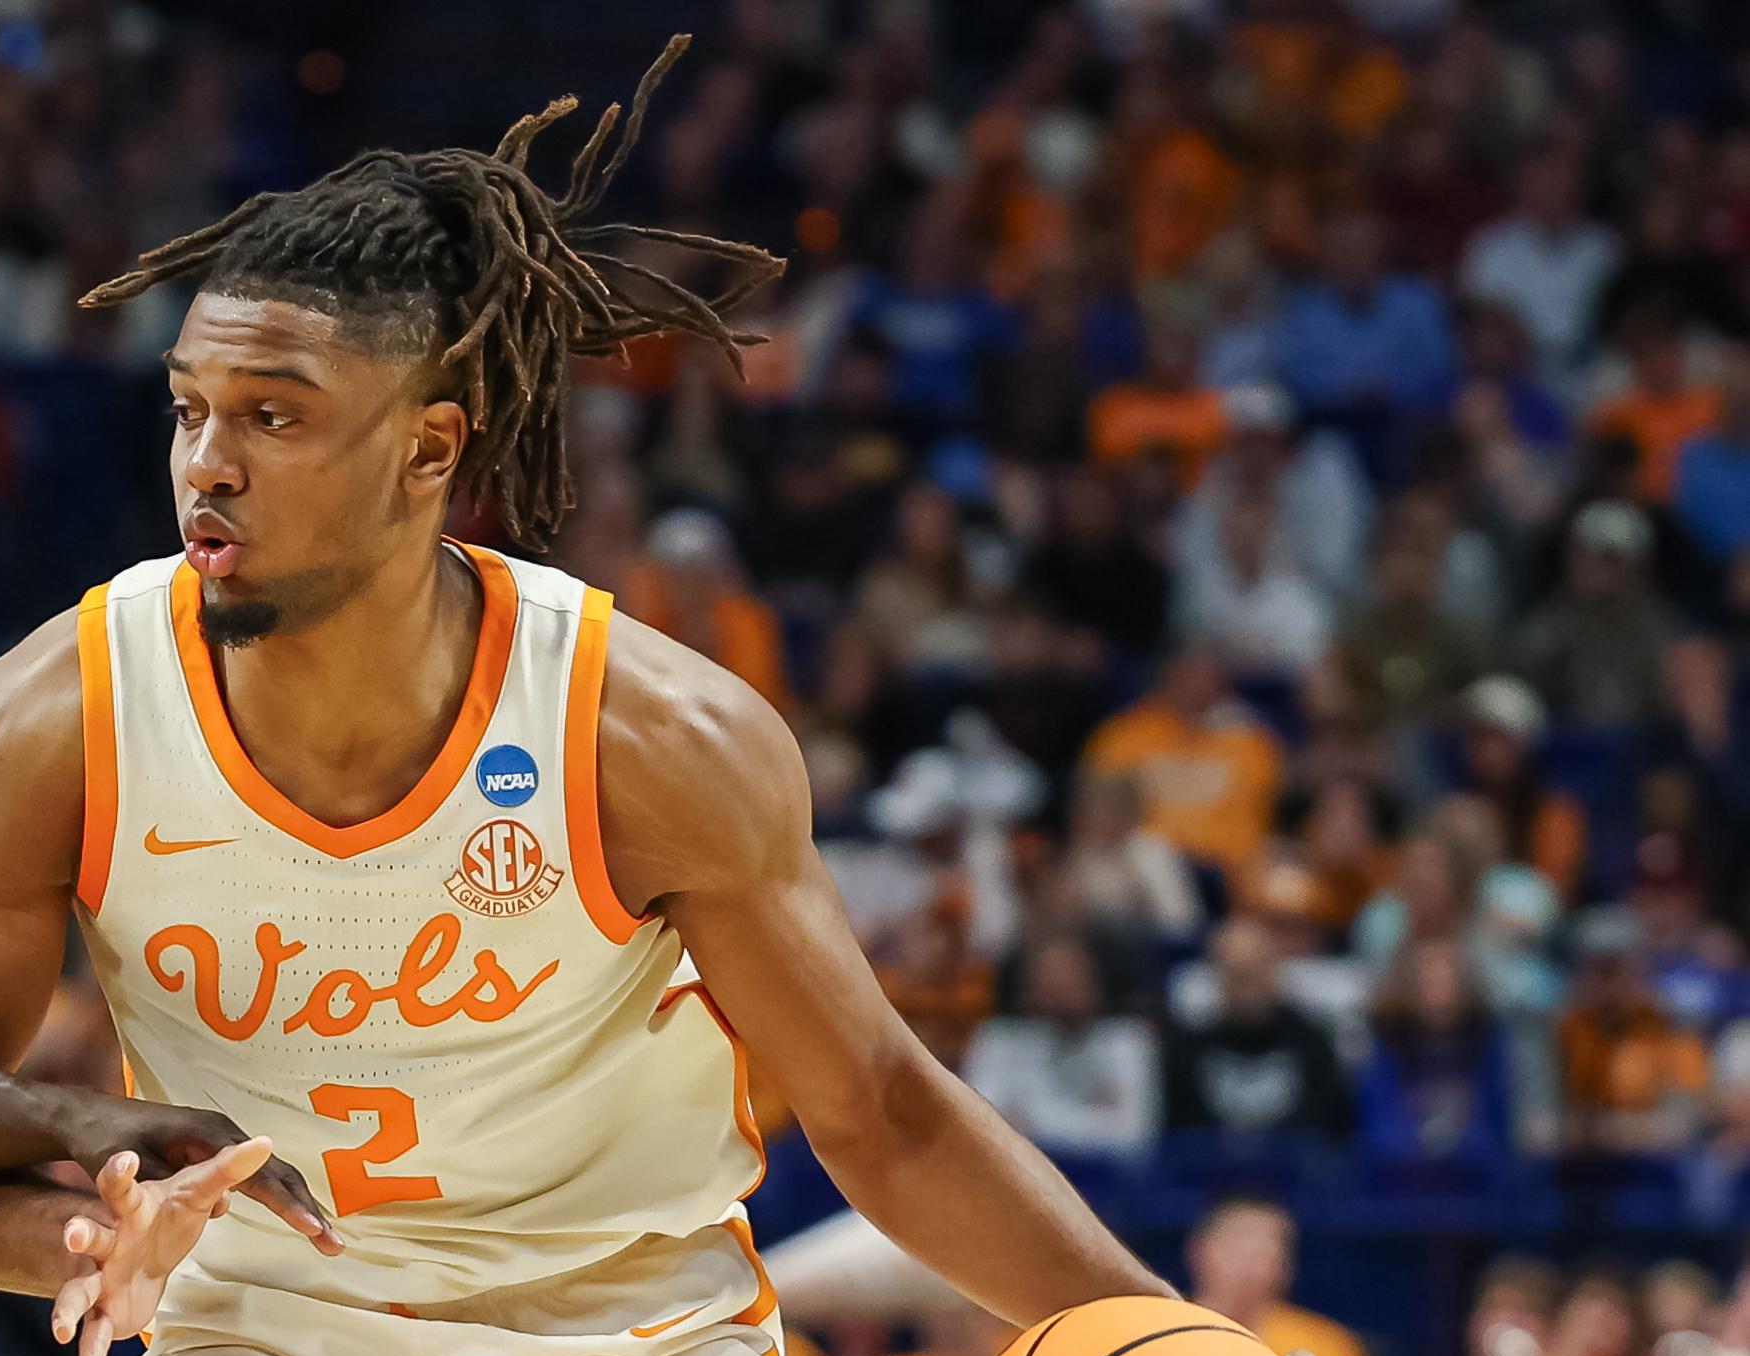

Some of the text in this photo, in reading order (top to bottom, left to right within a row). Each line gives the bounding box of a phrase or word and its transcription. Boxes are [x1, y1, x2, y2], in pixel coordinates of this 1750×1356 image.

[486, 773, 535, 791] NCAA
[466, 823, 537, 893] SEC
[458, 884, 549, 916] GRADUATE
[144, 913, 560, 1041] Vols
[307, 1083, 443, 1217] 2
